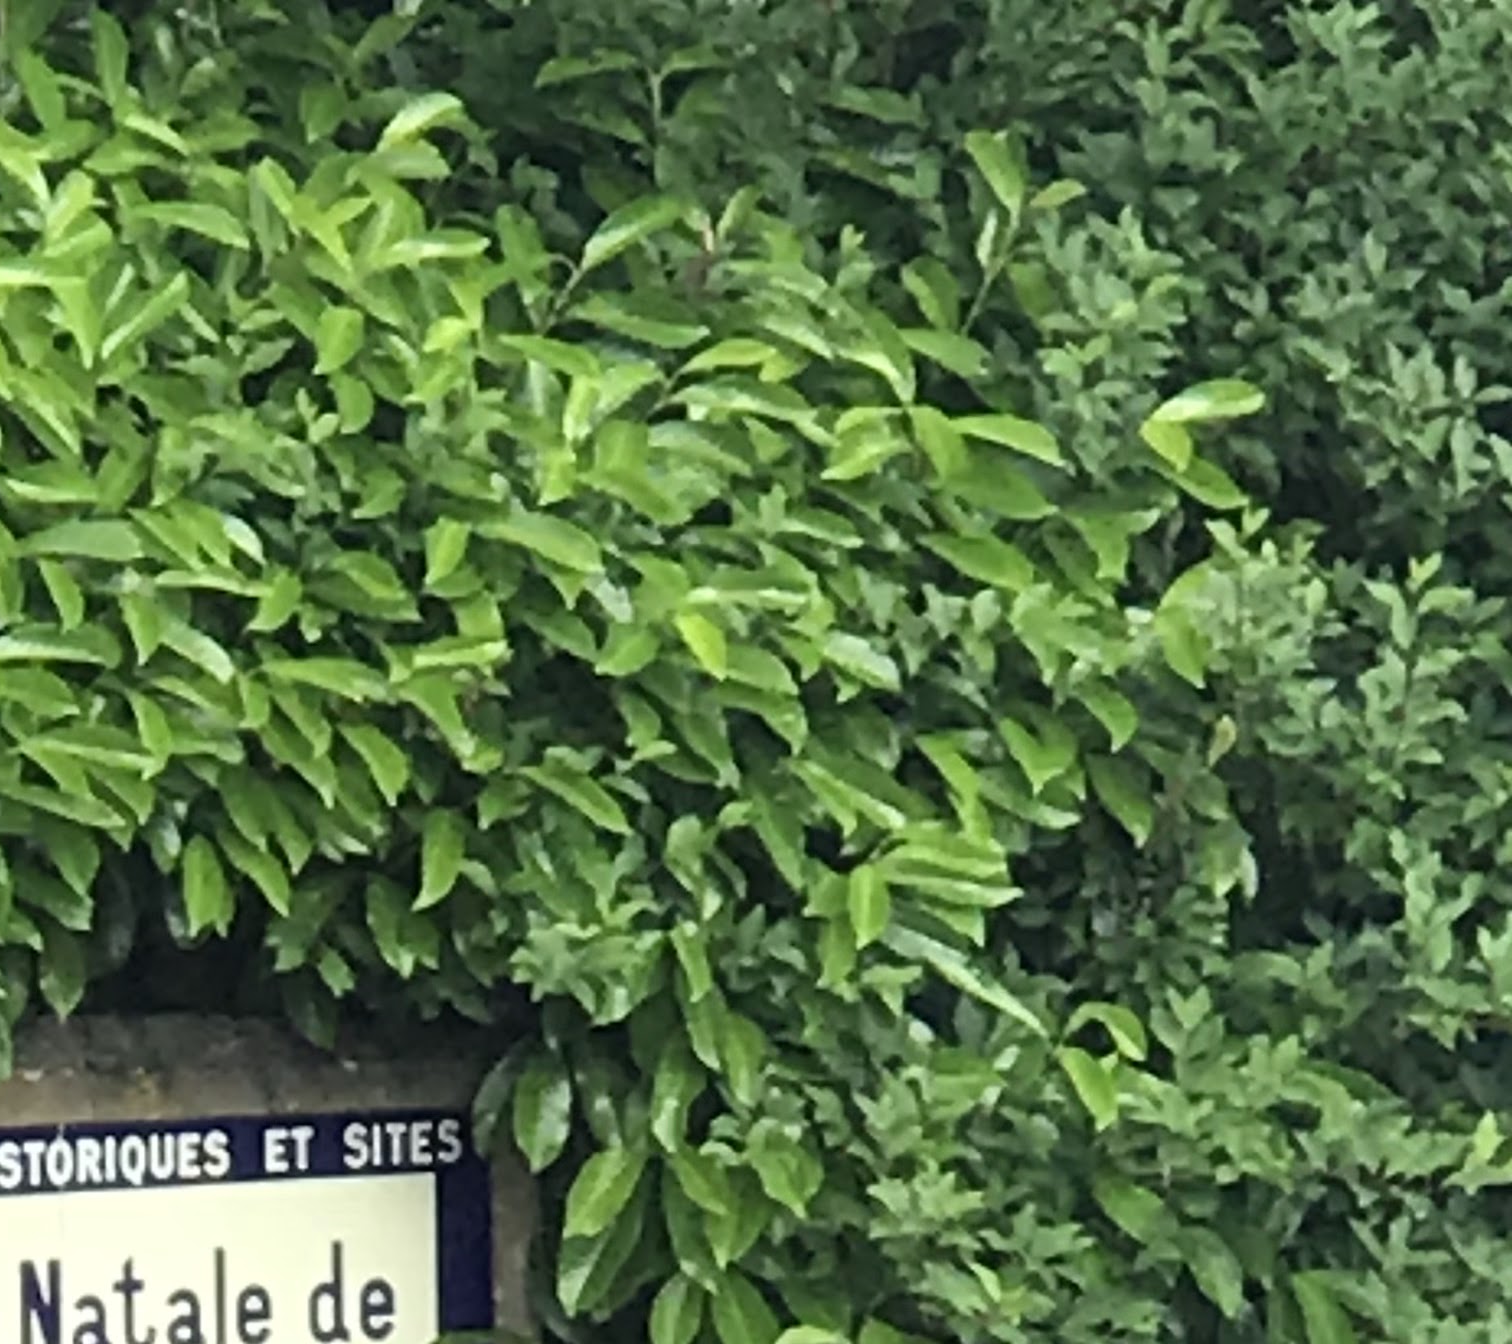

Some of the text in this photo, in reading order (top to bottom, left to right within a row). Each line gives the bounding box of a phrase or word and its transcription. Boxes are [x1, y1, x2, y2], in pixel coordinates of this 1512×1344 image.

[263, 1126, 315, 1174] ET
[343, 1118, 463, 1169] SITES
[308, 1239, 397, 1344] de
